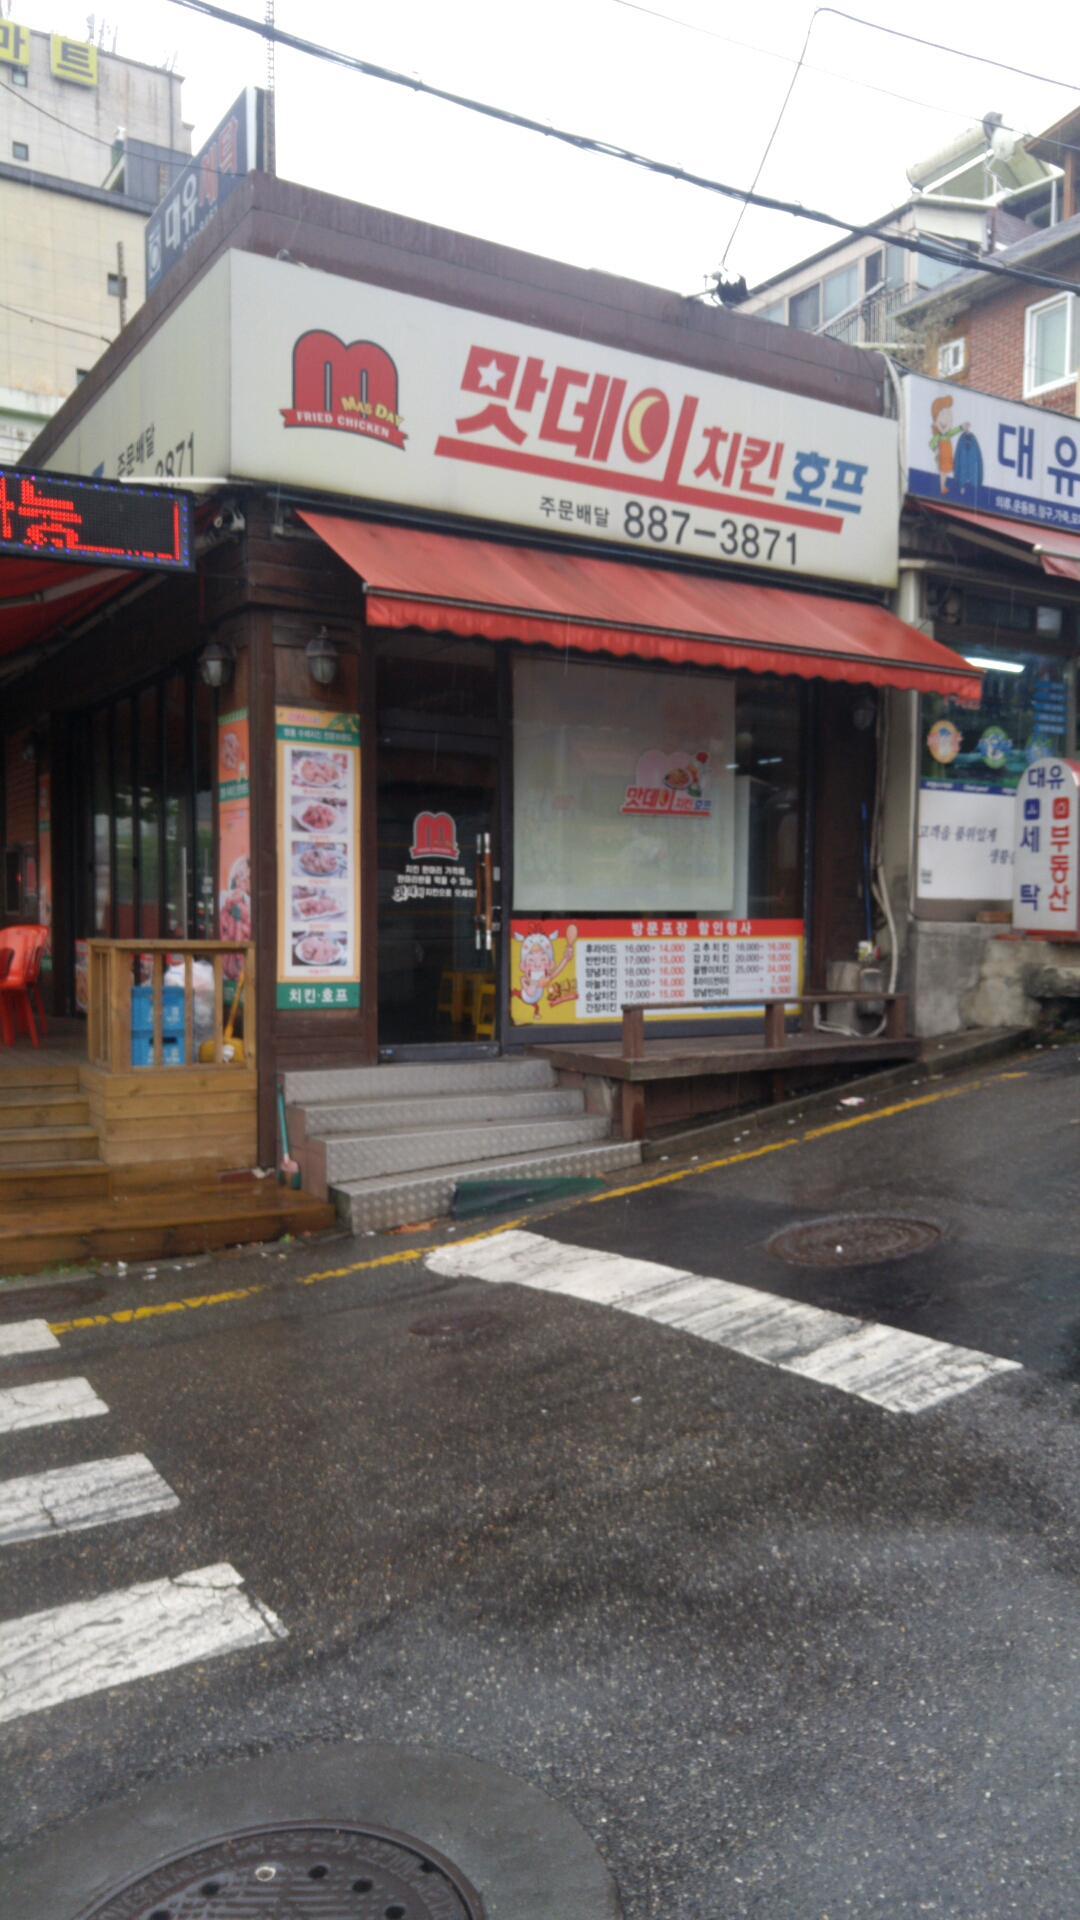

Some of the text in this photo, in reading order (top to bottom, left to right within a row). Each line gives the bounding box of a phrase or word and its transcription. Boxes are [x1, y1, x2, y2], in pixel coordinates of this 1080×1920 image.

[0, 24, 94, 78] 마트
[296, 410, 391, 439] FRIED CHICKEN
[455, 344, 869, 515] 맛데이 치킨 호프
[538, 495, 798, 566] 주문배달 887-3871
[1028, 765, 1066, 791] 대유
[1048, 826, 1071, 912] 부동산
[631, 921, 752, 937] 방문포장 할인행사
[585, 979, 618, 990] 마늘치킨
[585, 1002, 618, 1014] 간장치킨
